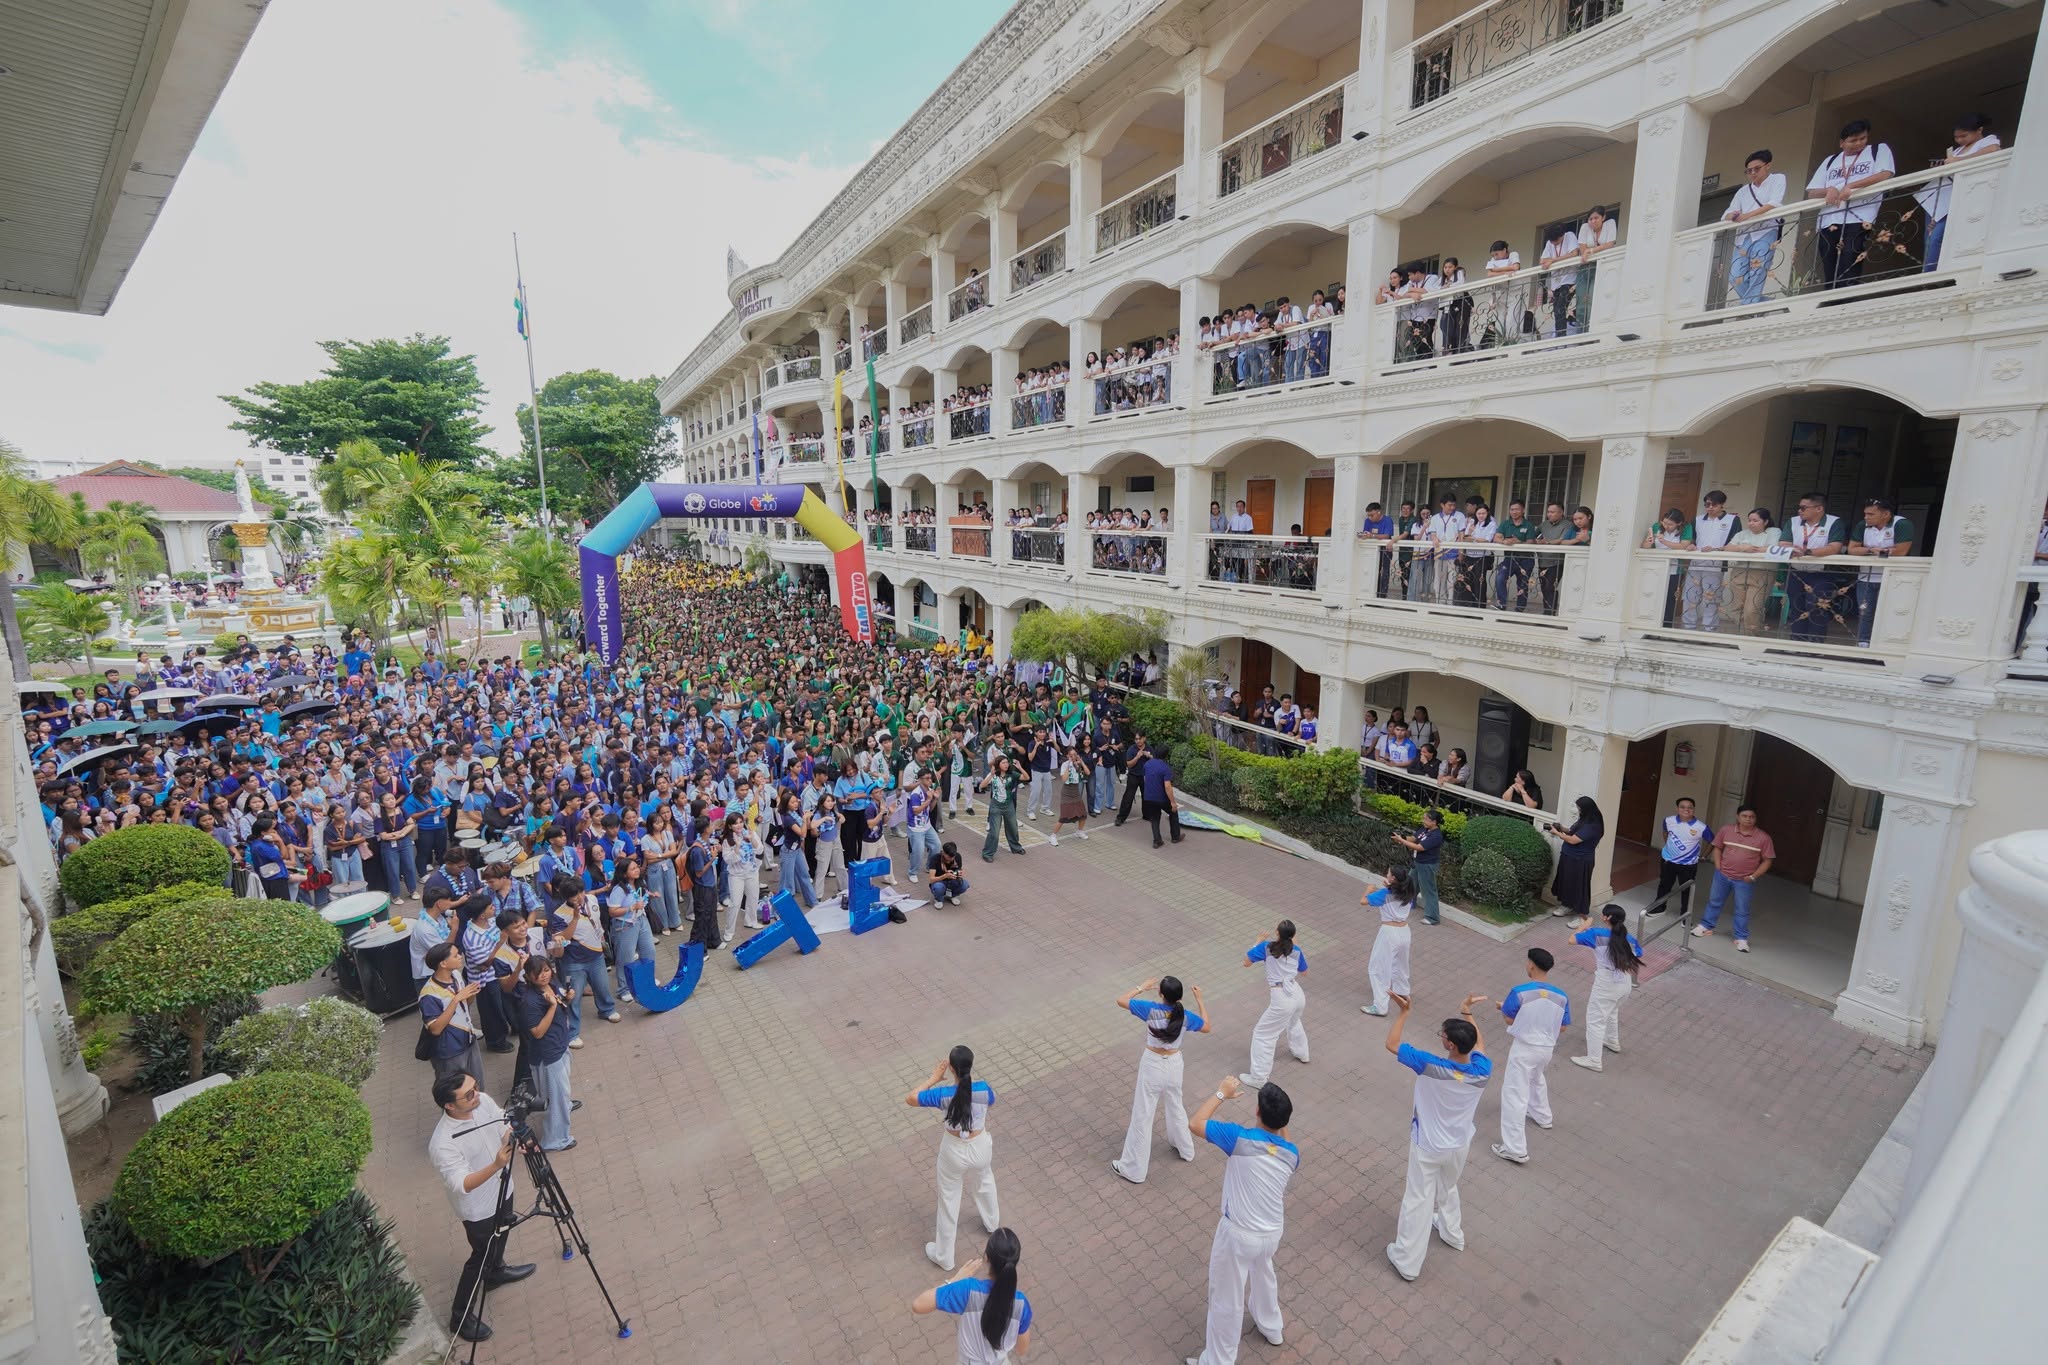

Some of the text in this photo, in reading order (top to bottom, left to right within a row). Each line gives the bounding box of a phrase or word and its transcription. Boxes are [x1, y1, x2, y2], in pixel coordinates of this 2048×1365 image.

[709, 499, 741, 509] Globe
[595, 573, 611, 668] Forward Together
